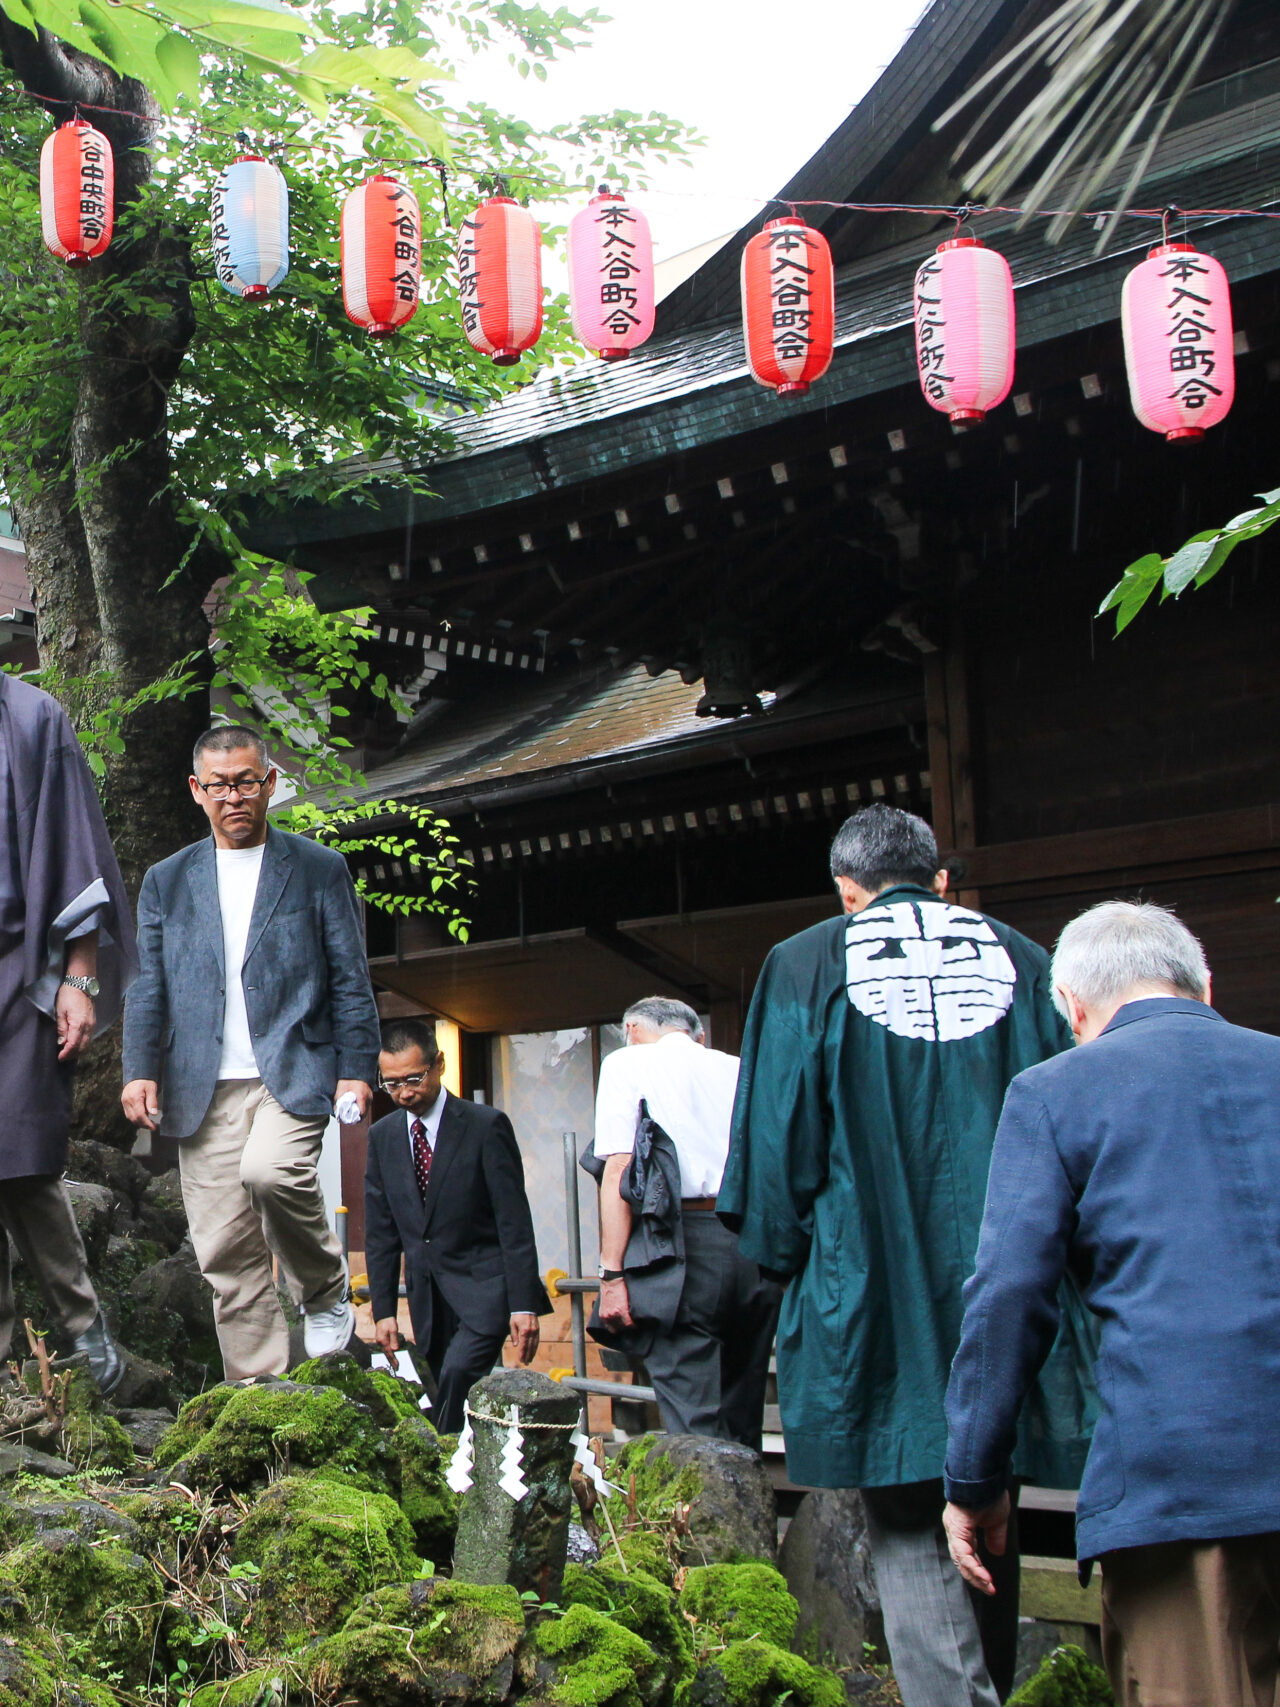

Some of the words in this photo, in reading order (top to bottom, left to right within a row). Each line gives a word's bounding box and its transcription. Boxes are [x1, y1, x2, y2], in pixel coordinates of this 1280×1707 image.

[77, 128, 107, 240] 入谷中央町会
[387, 186, 420, 302] 入谷町会
[594, 206, 641, 335] 本入谷町会
[762, 229, 819, 359] 本入谷町会
[915, 260, 956, 400] 本入谷町会
[1158, 256, 1223, 409] 本入谷町会
